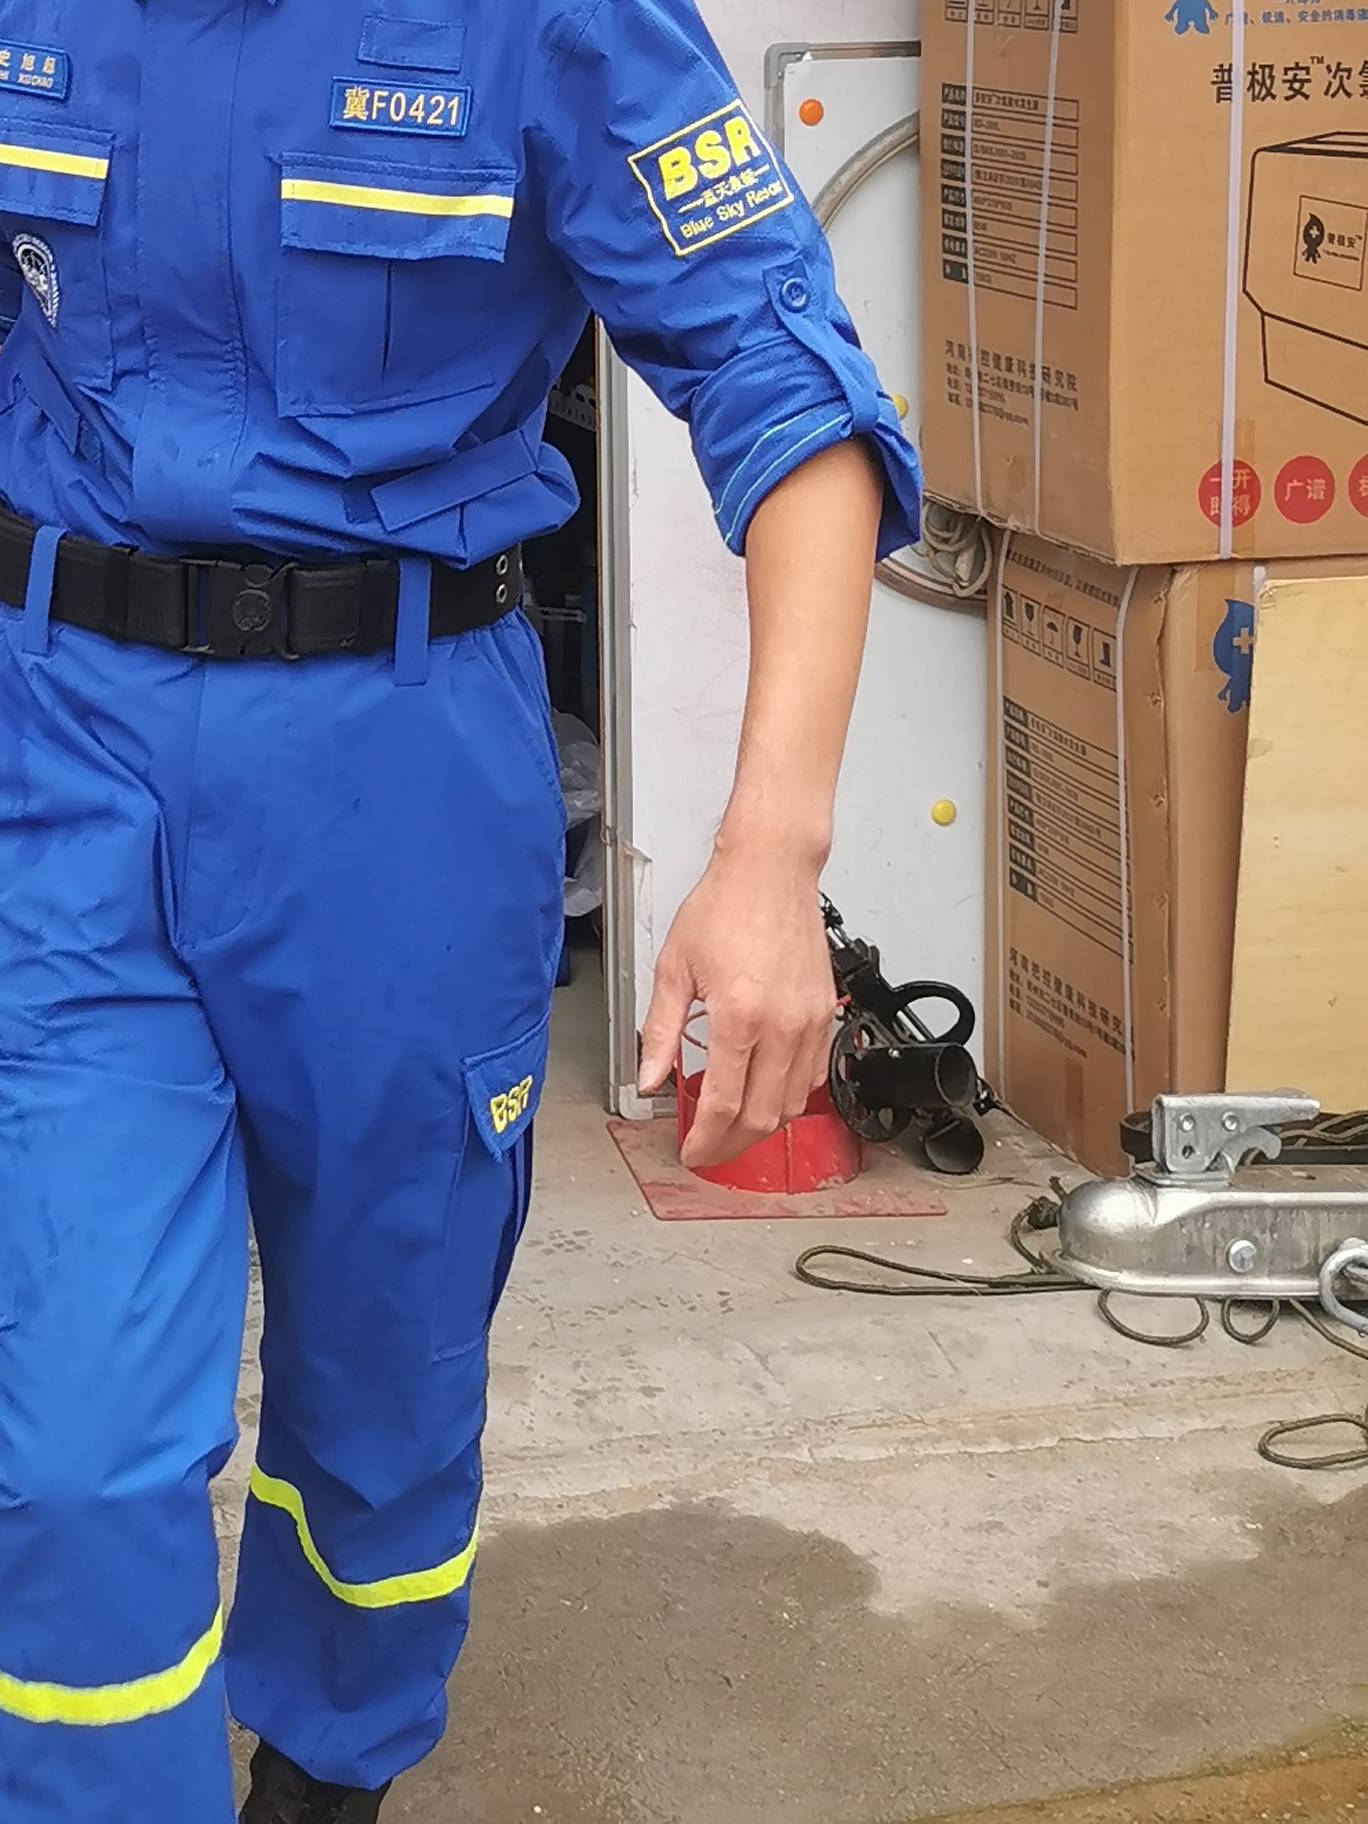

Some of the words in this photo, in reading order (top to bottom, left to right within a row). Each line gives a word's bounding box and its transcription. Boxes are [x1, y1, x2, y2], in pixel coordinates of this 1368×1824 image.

[343, 85, 460, 126] 冀F0421
[658, 116, 761, 201] BSR
[679, 216, 714, 239] Blue
[716, 199, 745, 222] Sky
[489, 1074, 533, 1134] BSR
